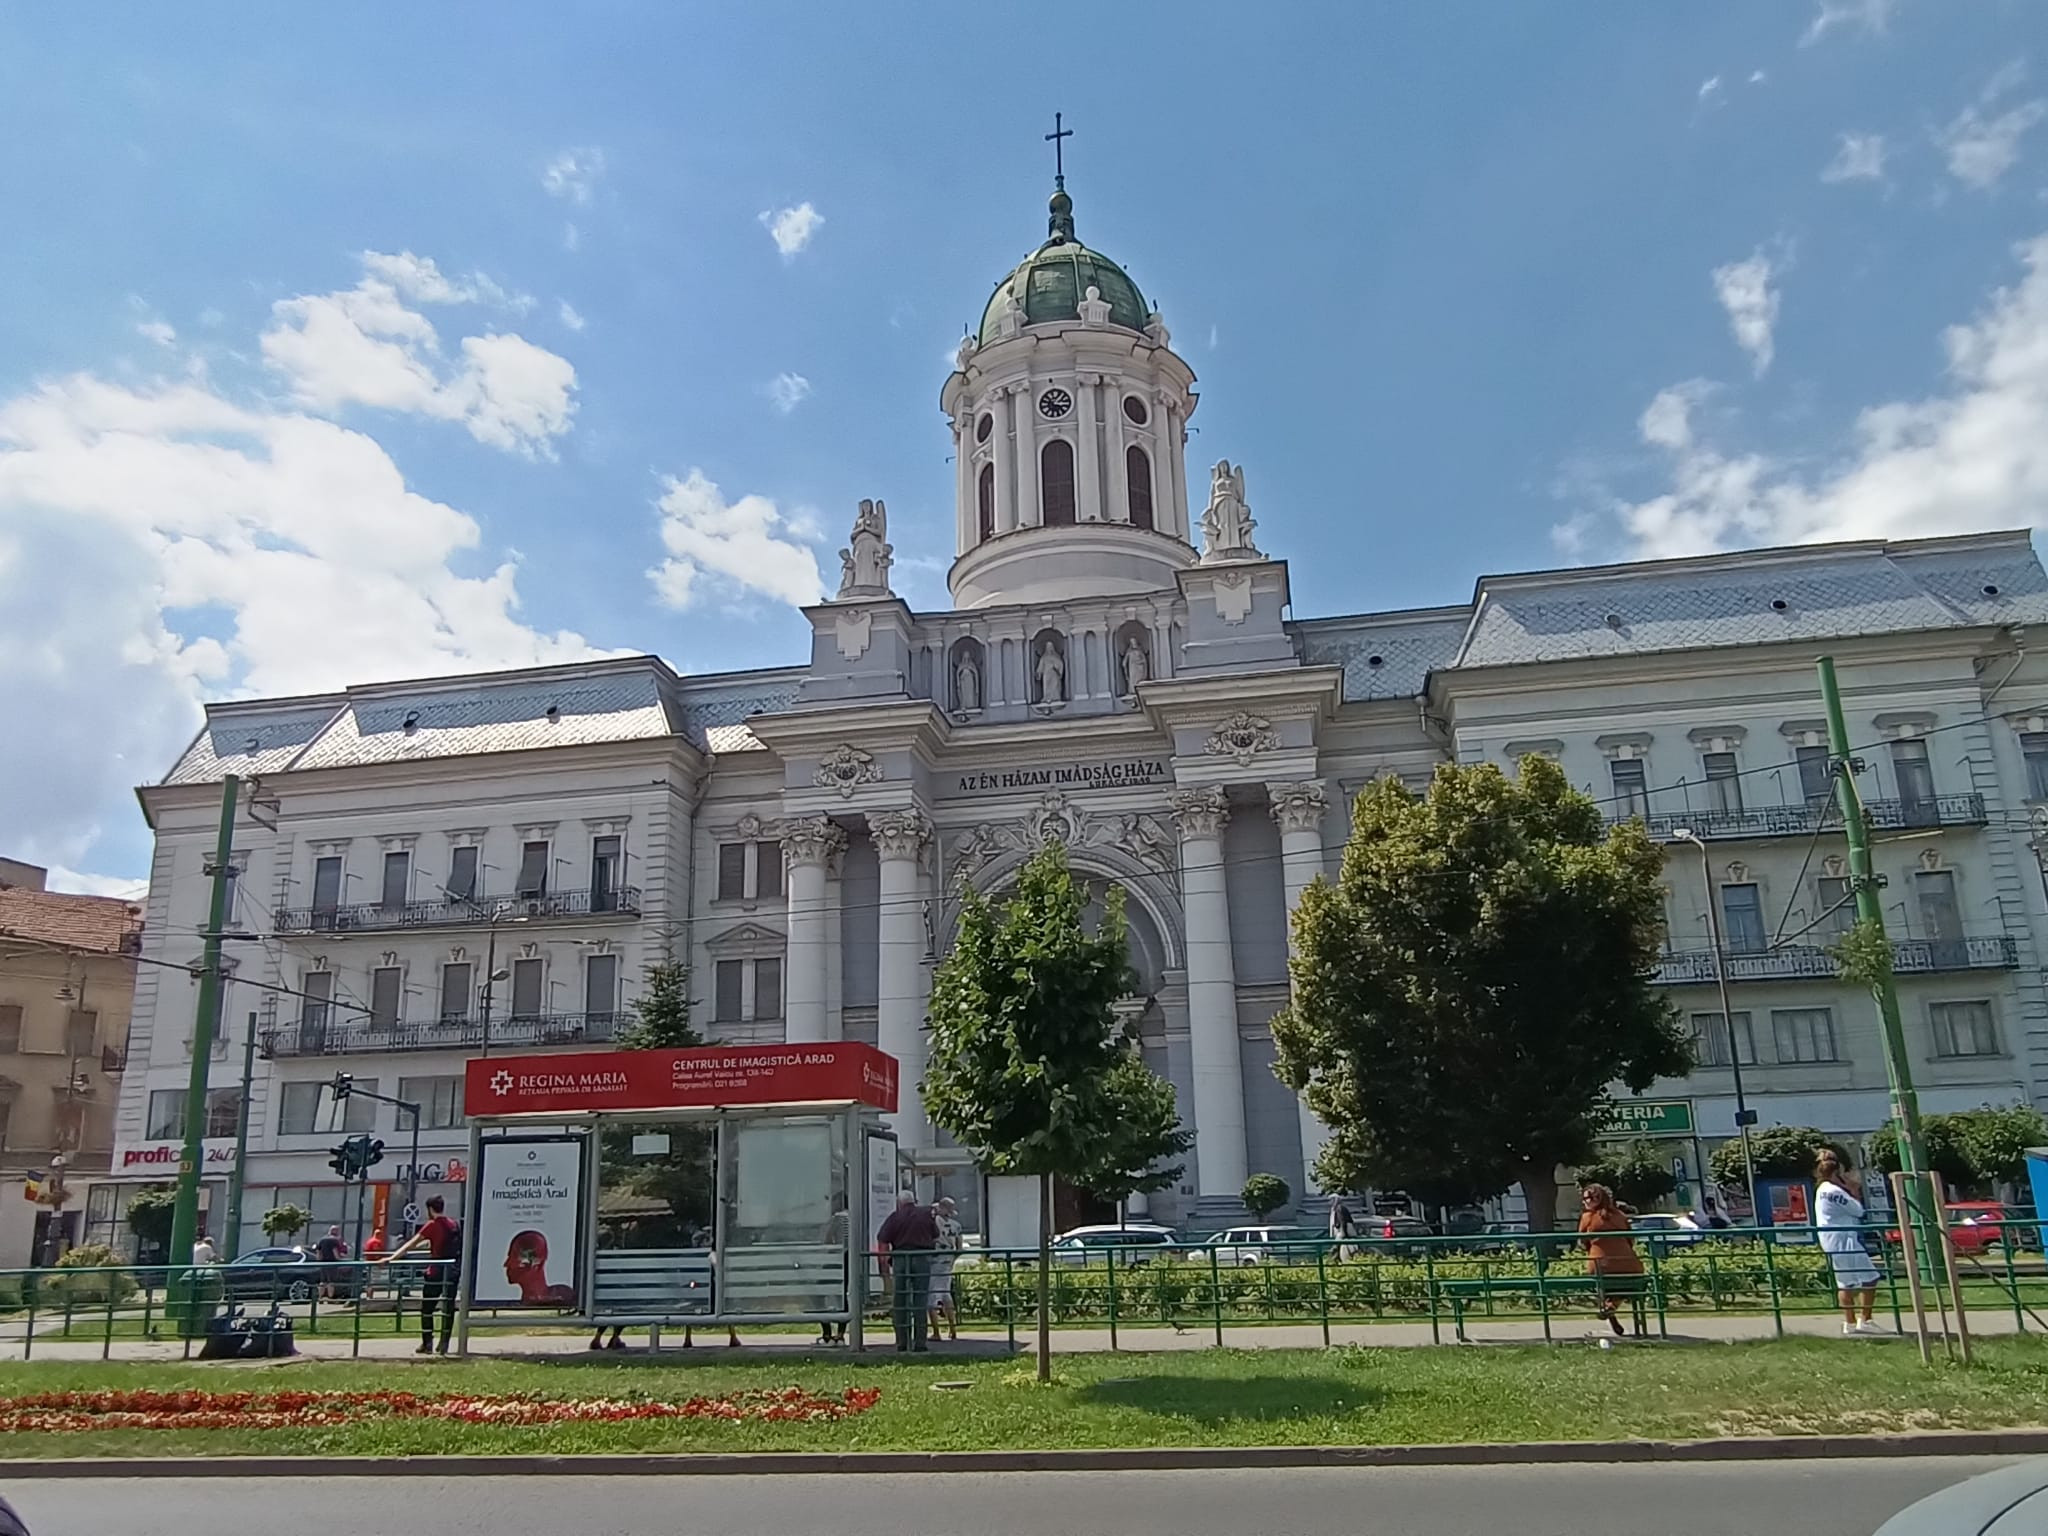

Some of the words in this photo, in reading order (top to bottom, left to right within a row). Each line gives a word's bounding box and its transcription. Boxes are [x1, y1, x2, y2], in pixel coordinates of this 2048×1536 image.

[959, 777, 977, 790] AZ
[980, 771, 998, 790] ÉN
[1002, 769, 1051, 787] HÁZAM
[1055, 762, 1122, 784] IMÁDSÁG
[1125, 759, 1164, 777] HÁZA
[672, 1060, 720, 1070] CENTRUL
[723, 1058, 737, 1068] DE
[804, 1054, 835, 1064] ARAD
[519, 1075, 575, 1087] REGINA
[579, 1071, 628, 1085] MARIA
[1610, 1105, 1665, 1120] TERIA
[396, 1163, 441, 1181] ING
[505, 1176, 542, 1187] Centrul
[543, 1175, 556, 1187] de
[544, 1187, 568, 1199] Arad
